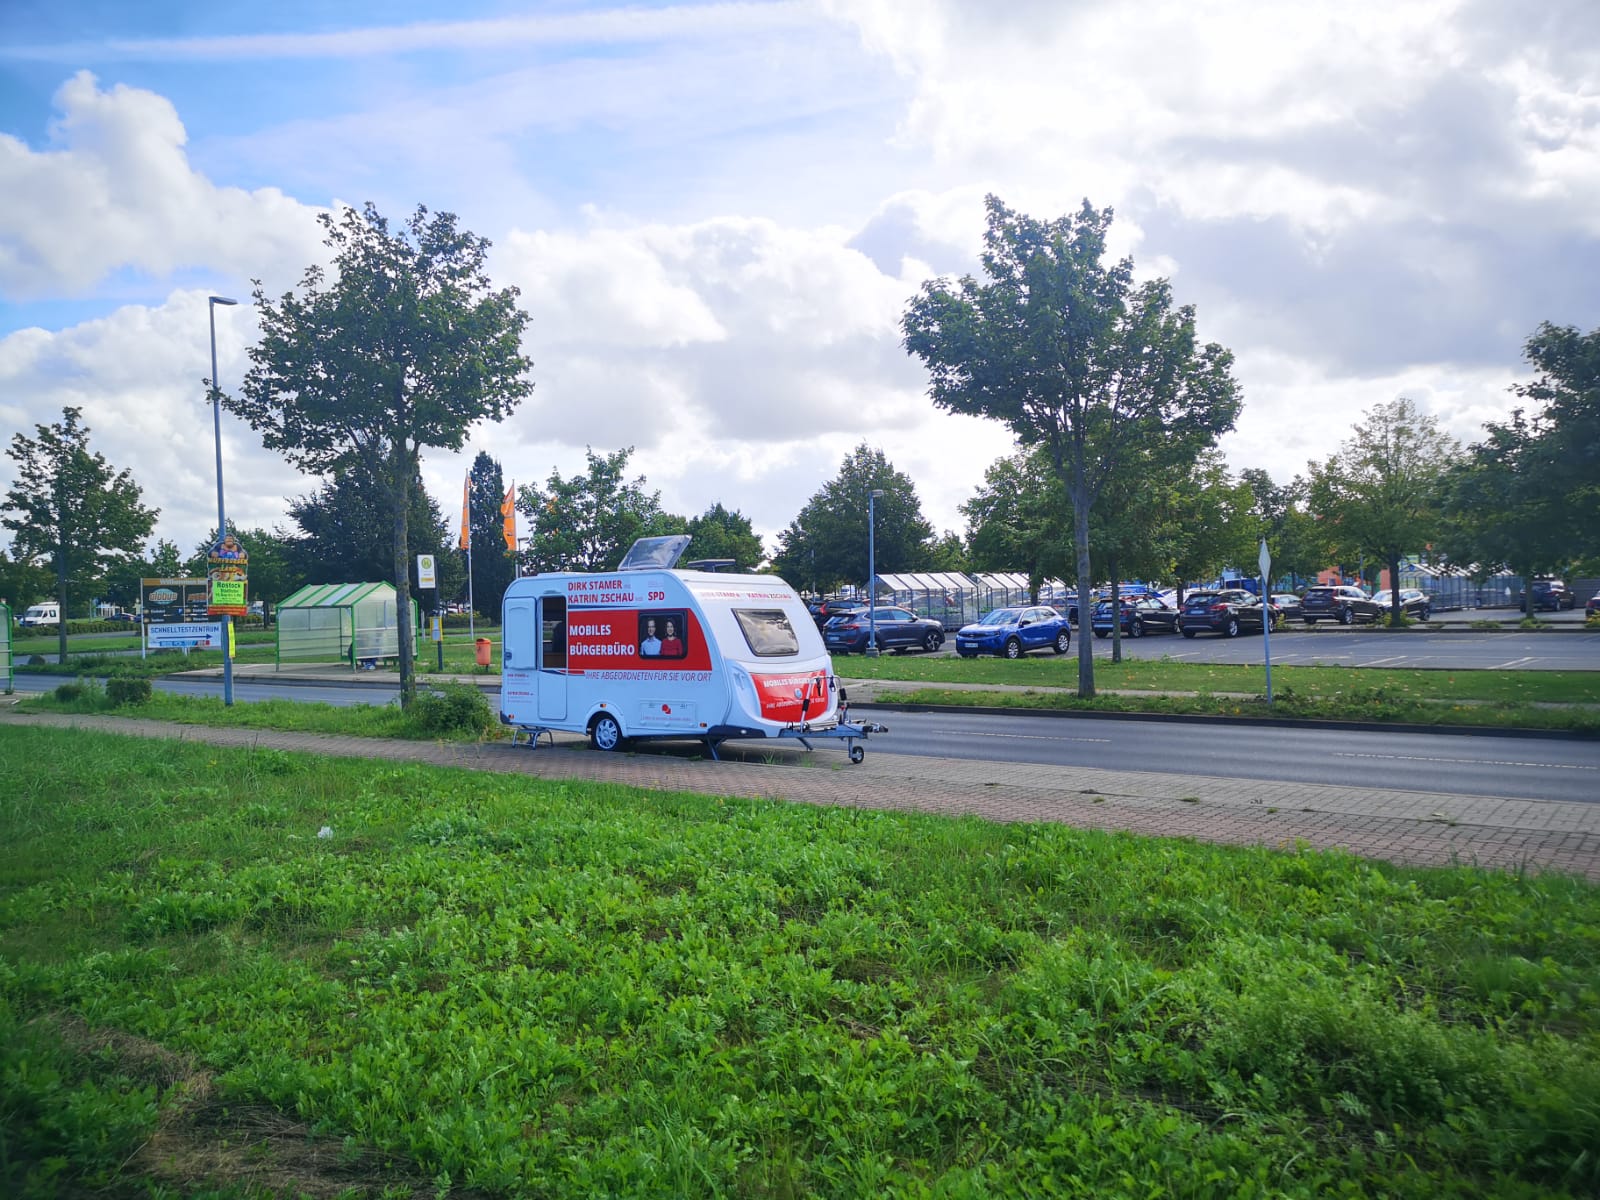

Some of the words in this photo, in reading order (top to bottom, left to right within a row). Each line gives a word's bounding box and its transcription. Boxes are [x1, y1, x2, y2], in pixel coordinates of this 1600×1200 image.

[568, 582, 587, 590] DIRK
[590, 580, 622, 590] STAMER
[568, 594, 598, 603] KATRIN
[600, 592, 634, 602] ZSCHAU
[648, 592, 664, 600] SPD
[150, 626, 219, 634] SCHNELLTESTZENTRUM
[570, 625, 612, 636] MOBILES
[570, 642, 635, 656] BÜRGERBÜRO
[586, 672, 599, 680] IHRE
[601, 672, 654, 680] ABGEORDNETEN
[654, 671, 666, 680] FÜR
[668, 672, 680, 681] SIE
[682, 672, 696, 681] VOR
[697, 672, 712, 682] ORT
